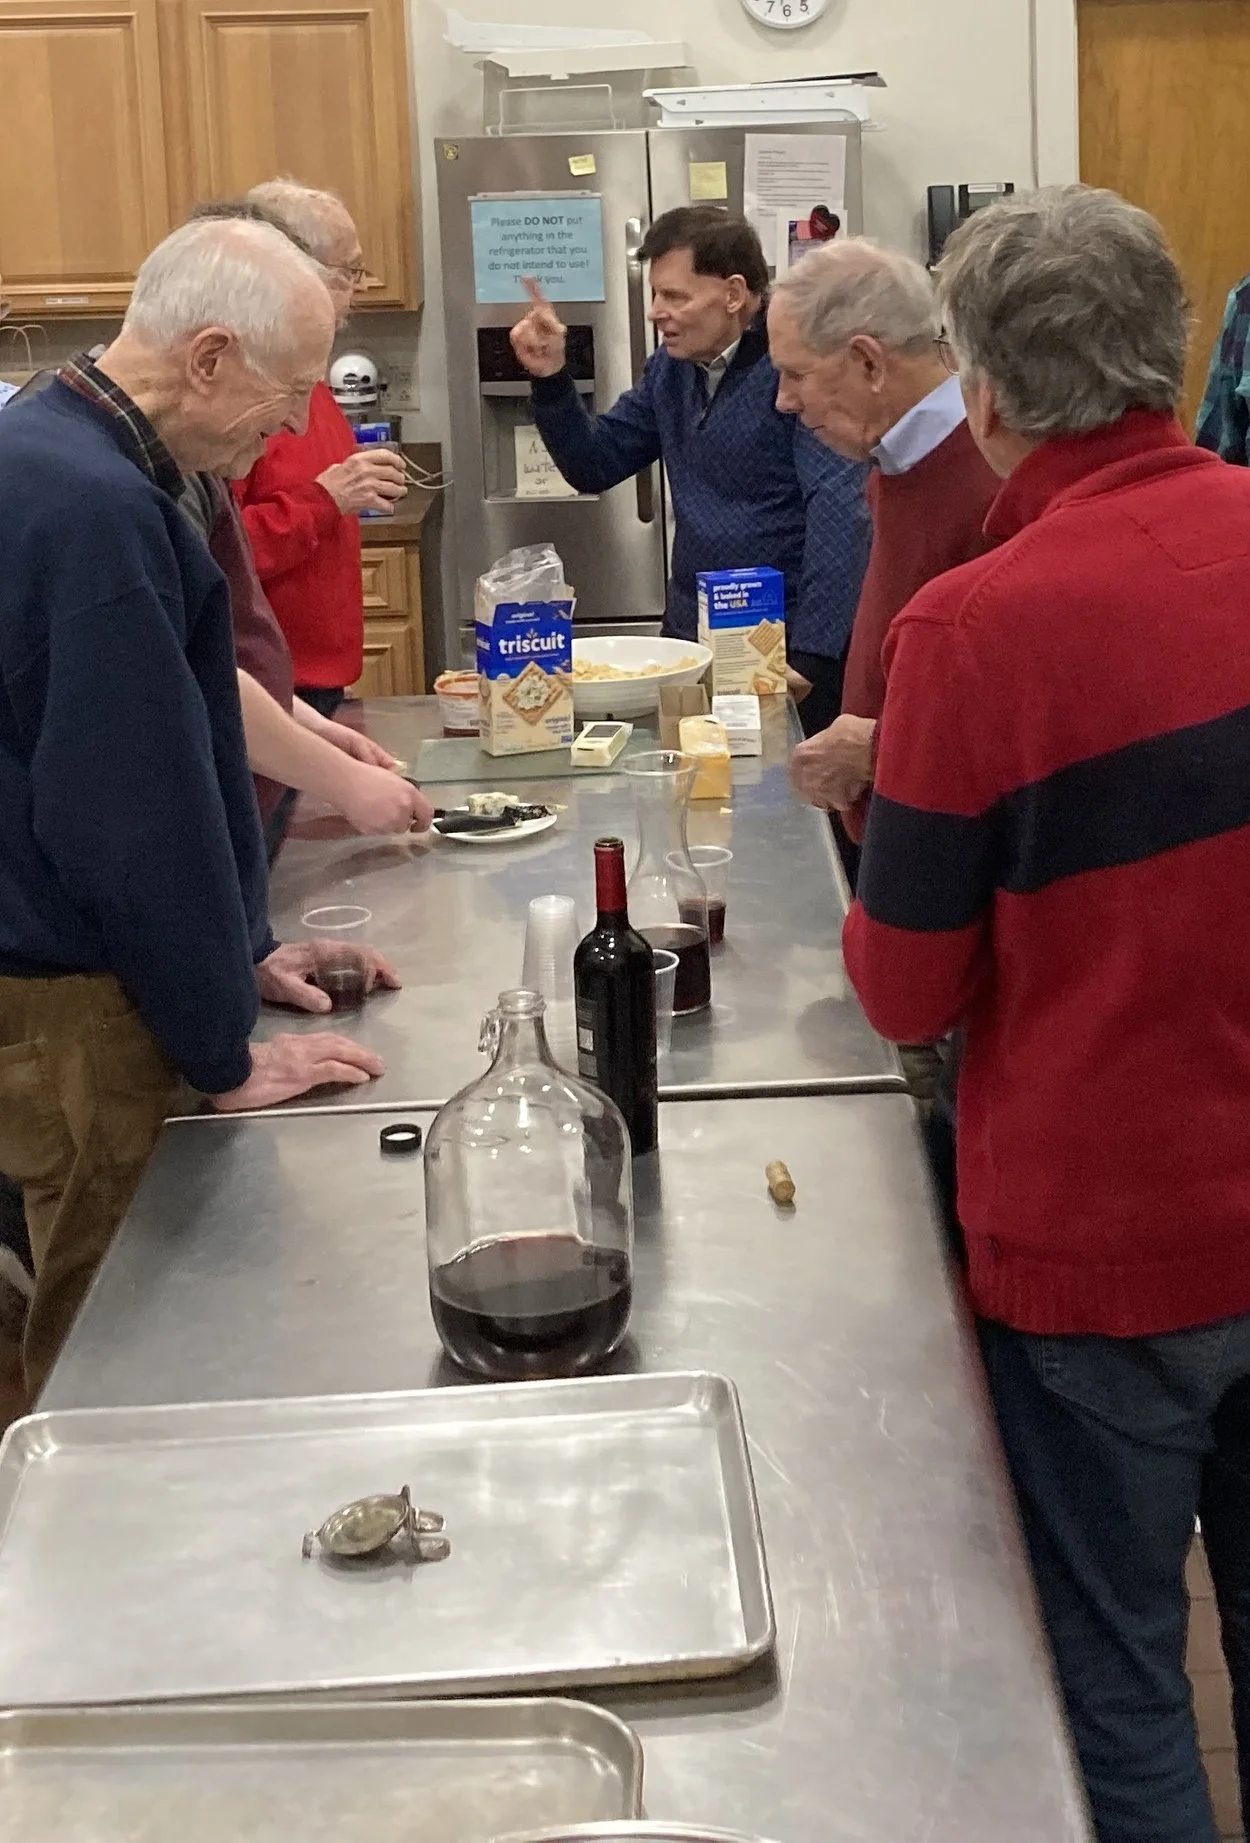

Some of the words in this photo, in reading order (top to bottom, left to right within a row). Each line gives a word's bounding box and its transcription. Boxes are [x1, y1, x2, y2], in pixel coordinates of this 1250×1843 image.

[766, 0, 775, 13] 7
[782, 4, 792, 17] 6
[799, 0, 809, 12] 5
[490, 217, 522, 227] Please
[524, 216, 540, 225] DO
[542, 216, 564, 226] NOT
[566, 216, 583, 226] put
[501, 231, 544, 242] anything
[545, 231, 555, 240] in
[557, 231, 574, 240] the
[488, 246, 544, 257] refrigerator
[547, 245, 567, 255] that
[569, 246, 588, 255] you
[487, 261, 501, 271] do
[503, 261, 520, 270] not
[522, 260, 553, 270] intend
[556, 260, 567, 269] to
[568, 259, 590, 269] use!
[498, 631, 566, 655] triscuit
